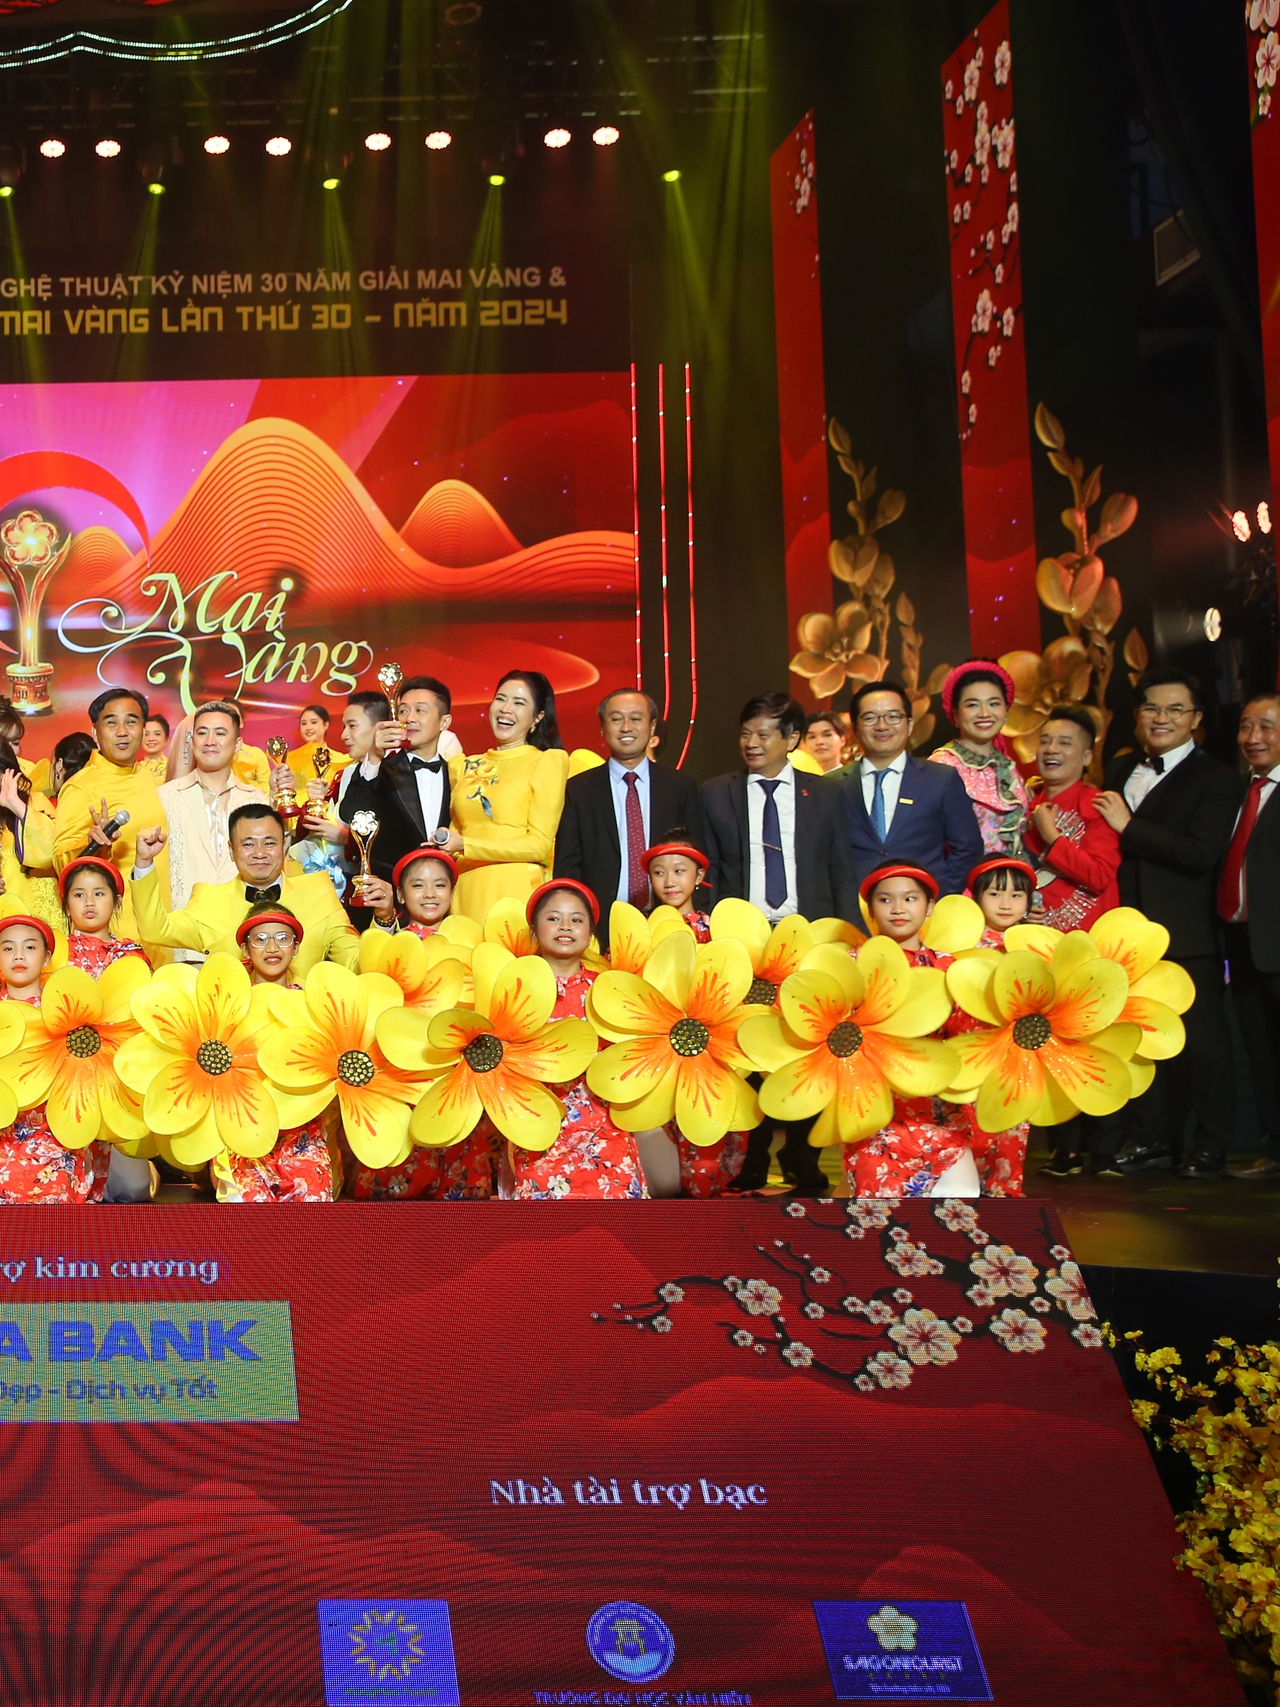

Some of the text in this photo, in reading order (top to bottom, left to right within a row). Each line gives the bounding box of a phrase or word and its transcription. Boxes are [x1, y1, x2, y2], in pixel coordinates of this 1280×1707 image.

[59, 274, 144, 300] THUẬT
[150, 270, 185, 295] KỶ
[192, 271, 253, 298] NIỆM
[260, 272, 288, 292] 30
[295, 267, 351, 292] NĂM
[359, 265, 409, 291] GIẢI
[417, 268, 462, 290] MAI
[469, 264, 542, 289] VÀNG
[548, 266, 567, 288] &
[63, 304, 150, 335] VÀNG
[162, 297, 223, 333] LẦN
[235, 299, 301, 332] THỨ
[311, 303, 351, 331] 30
[393, 297, 468, 328] NĂM
[479, 299, 568, 327] 2024
[34, 1256, 102, 1279] kim
[110, 1259, 220, 1285] cương
[48, 1320, 261, 1362] BANK
[66, 1379, 125, 1404] Dịch
[170, 1375, 218, 1400] Tốt
[489, 1475, 768, 1510] Nhà tài trợ bạc
